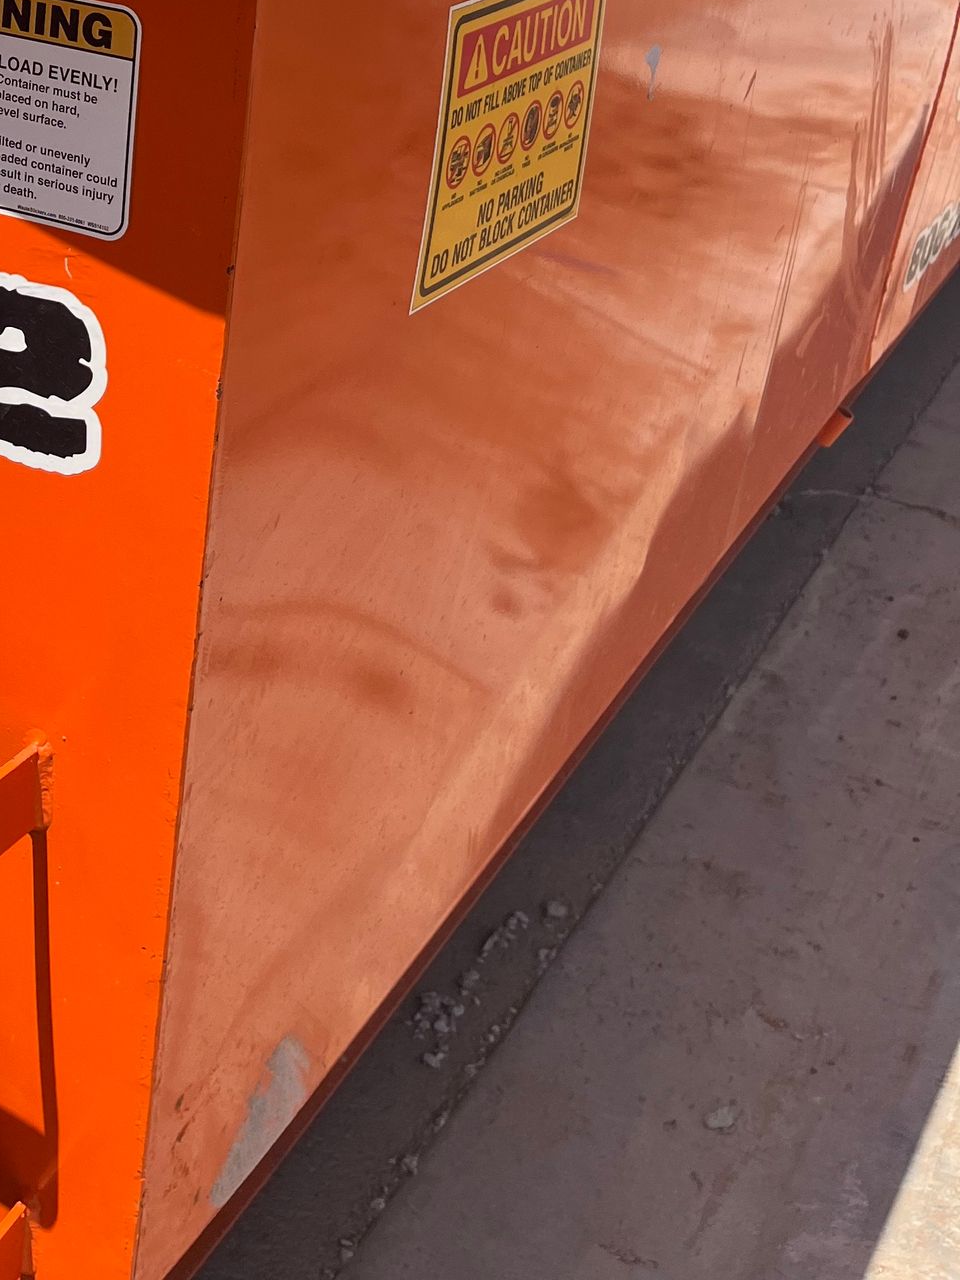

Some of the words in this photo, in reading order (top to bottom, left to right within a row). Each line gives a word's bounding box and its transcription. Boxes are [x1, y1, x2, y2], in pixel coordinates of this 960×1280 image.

[48, 64, 118, 93] EVENLY!
[450, 106, 464, 130] DO
[465, 98, 482, 120] NOT
[483, 90, 500, 113] FILL
[501, 78, 527, 106] ABOVE
[528, 70, 542, 93] TOP
[543, 65, 554, 86] OF
[554, 48, 592, 81] CONTAINER
[34, 99, 49, 110] on
[51, 100, 80, 118] hard,
[53, 87, 81, 101] must
[83, 92, 98, 105] be
[22, 112, 67, 129] surface.
[25, 143, 37, 153] or
[40, 146, 91, 168] unevenly
[30, 160, 83, 180] container
[86, 173, 118, 188] could
[3, 183, 37, 200] death.
[24, 172, 34, 184] in
[37, 177, 79, 194] serious
[82, 185, 115, 205] injury
[477, 199, 494, 227] NO
[497, 171, 544, 216] PARKING
[431, 249, 449, 279] DO
[452, 233, 477, 267] NOT
[479, 211, 516, 251] BLOCK
[518, 179, 574, 229] CONTAINER
